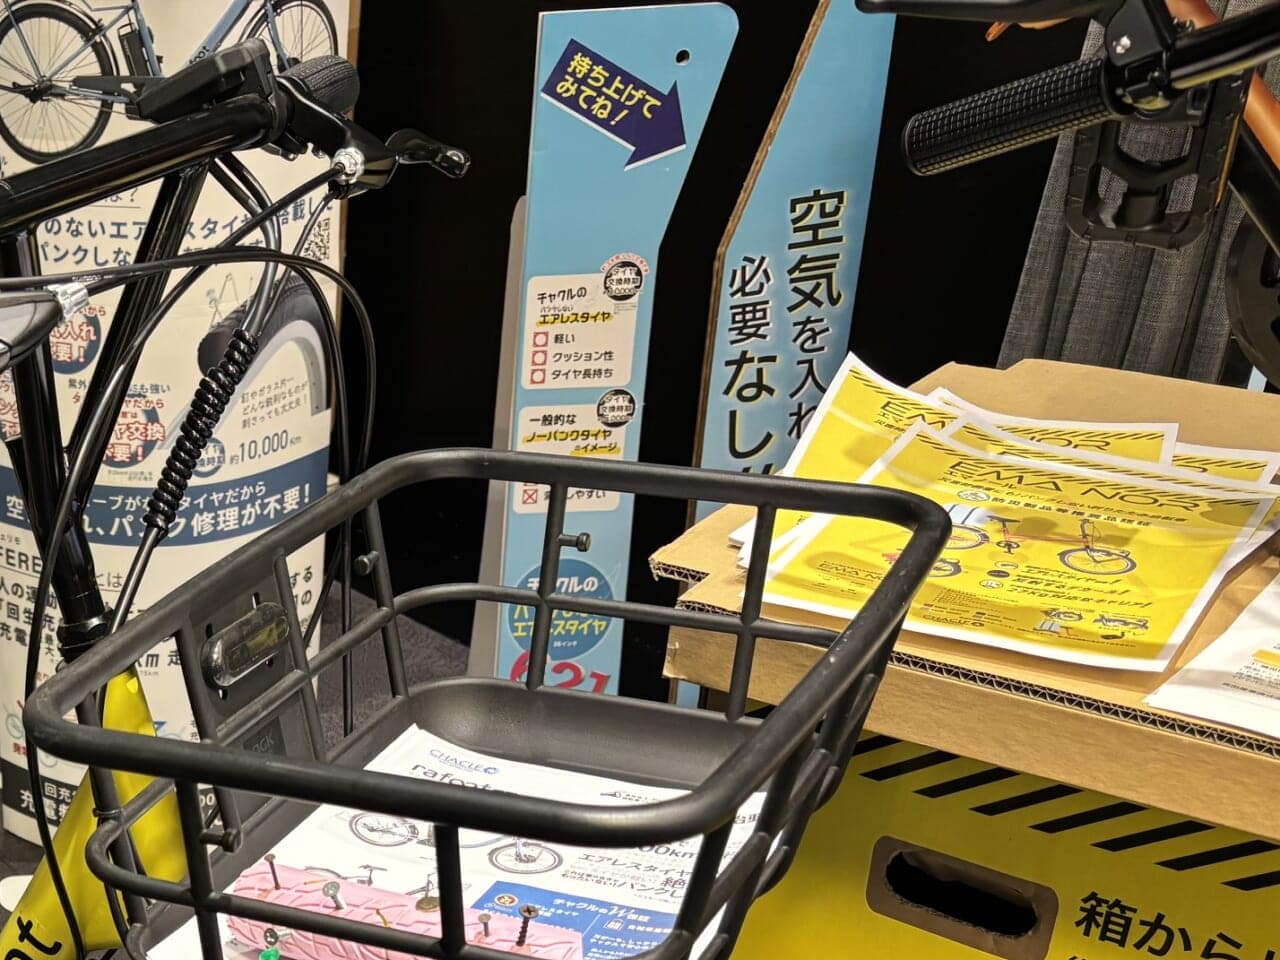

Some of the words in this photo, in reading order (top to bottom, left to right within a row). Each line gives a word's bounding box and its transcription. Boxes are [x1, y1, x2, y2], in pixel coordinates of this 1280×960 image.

[566, 51, 662, 120] 持ち上げて
[555, 75, 629, 127] みてね!
[536, 287, 588, 305] チャクルの
[539, 310, 612, 326] エアレスタイヤ
[553, 332, 575, 345] 軽い
[551, 349, 615, 364] クッション性
[721, 254, 780, 476] 必要なし
[551, 366, 614, 381] タイヤ長持ち
[529, 413, 577, 427] 一般的な
[525, 428, 613, 443] ノーパンクタイヤ
[949, 460, 1062, 492] EMA
[1079, 486, 1201, 513] NOR
[429, 747, 484, 774] CHACLE
